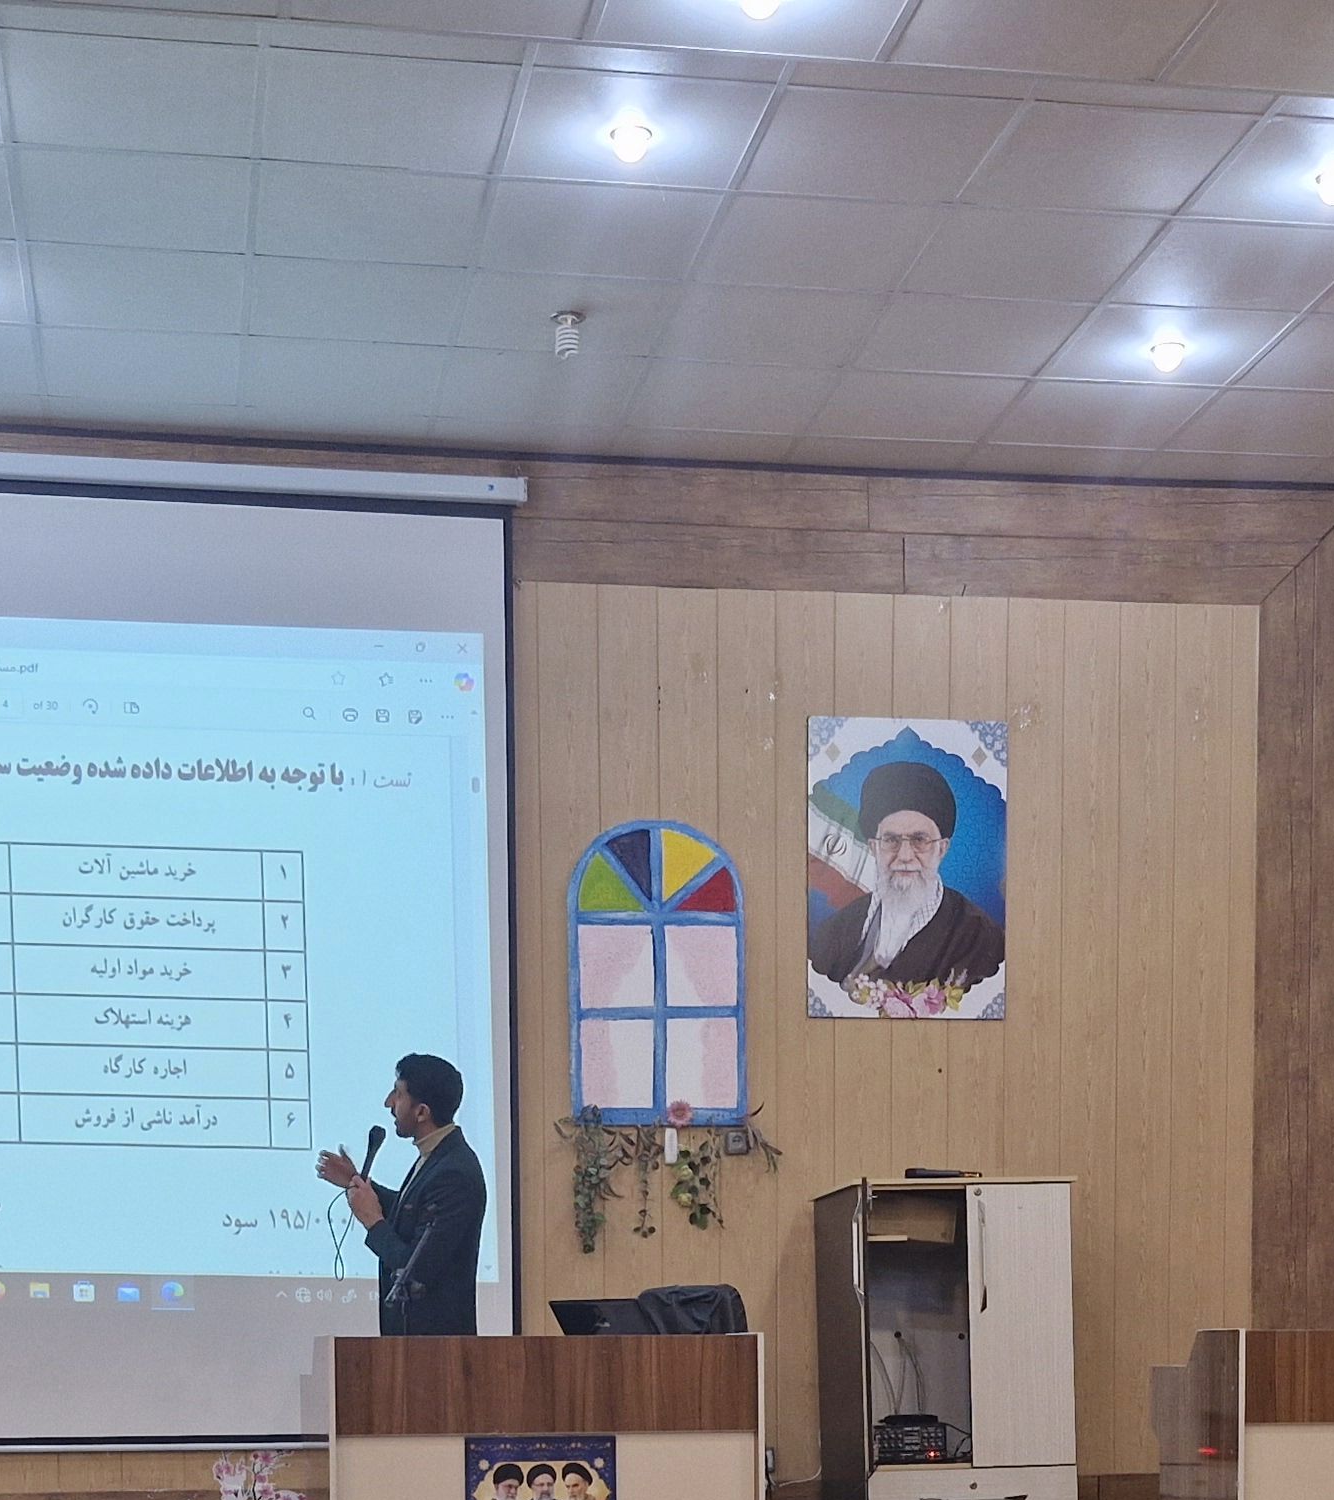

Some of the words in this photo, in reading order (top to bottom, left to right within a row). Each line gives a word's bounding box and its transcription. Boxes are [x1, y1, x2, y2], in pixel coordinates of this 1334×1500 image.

[16, 754, 83, 786] وضعیت
[86, 755, 127, 779] شده
[130, 756, 173, 781] داده
[177, 757, 254, 783] اطلاعات
[258, 765, 277, 790] به
[280, 762, 326, 793] توجه
[329, 762, 345, 793] با
[78, 852, 112, 875] آلات
[119, 859, 159, 881] ماشین
[164, 862, 197, 882] خرید
[62, 903, 118, 929] کارگران
[123, 911, 160, 931] حقوق
[165, 909, 216, 935] پرداخت
[90, 957, 122, 979] اولیه
[126, 958, 155, 981] مواد
[159, 962, 192, 982] خرید
[94, 1006, 152, 1030] استهلاک
[156, 1013, 192, 1032] هزینه
[103, 1053, 147, 1079] کارگاه
[153, 1058, 187, 1080] اجاره
[74, 1107, 116, 1129] فروش
[121, 1106, 135, 1129] از
[140, 1107, 173, 1132] ناشی
[222, 1213, 258, 1236] سود
